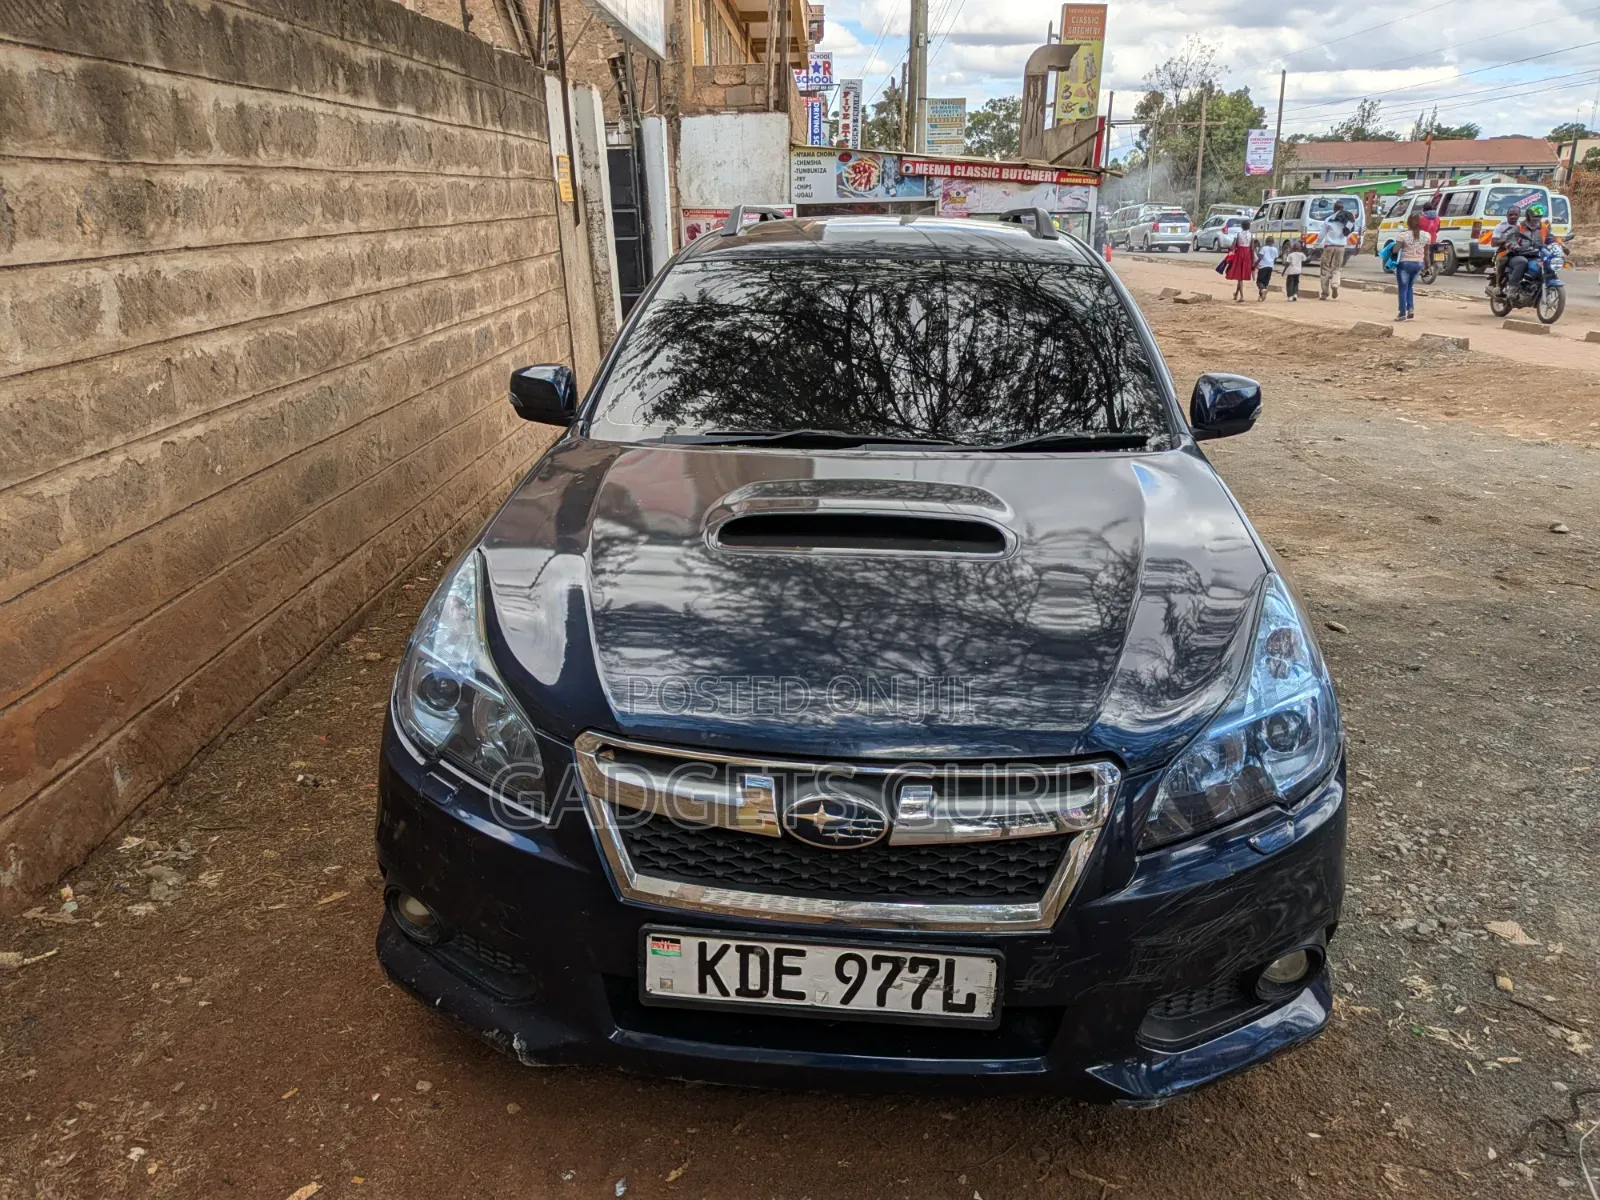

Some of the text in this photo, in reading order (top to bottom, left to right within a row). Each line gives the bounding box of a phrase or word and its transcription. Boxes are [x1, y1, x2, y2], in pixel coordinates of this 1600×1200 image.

[1071, 15, 1099, 24] CLASSIC
[1067, 26, 1102, 35] BUTCHERY
[796, 75, 834, 84] SCHOOL
[842, 91, 850, 120] FIVE
[915, 163, 1060, 182] NEEMA CLASSIC BUTCHERY
[697, 940, 808, 1001] KDE
[834, 952, 978, 1014] 977L
